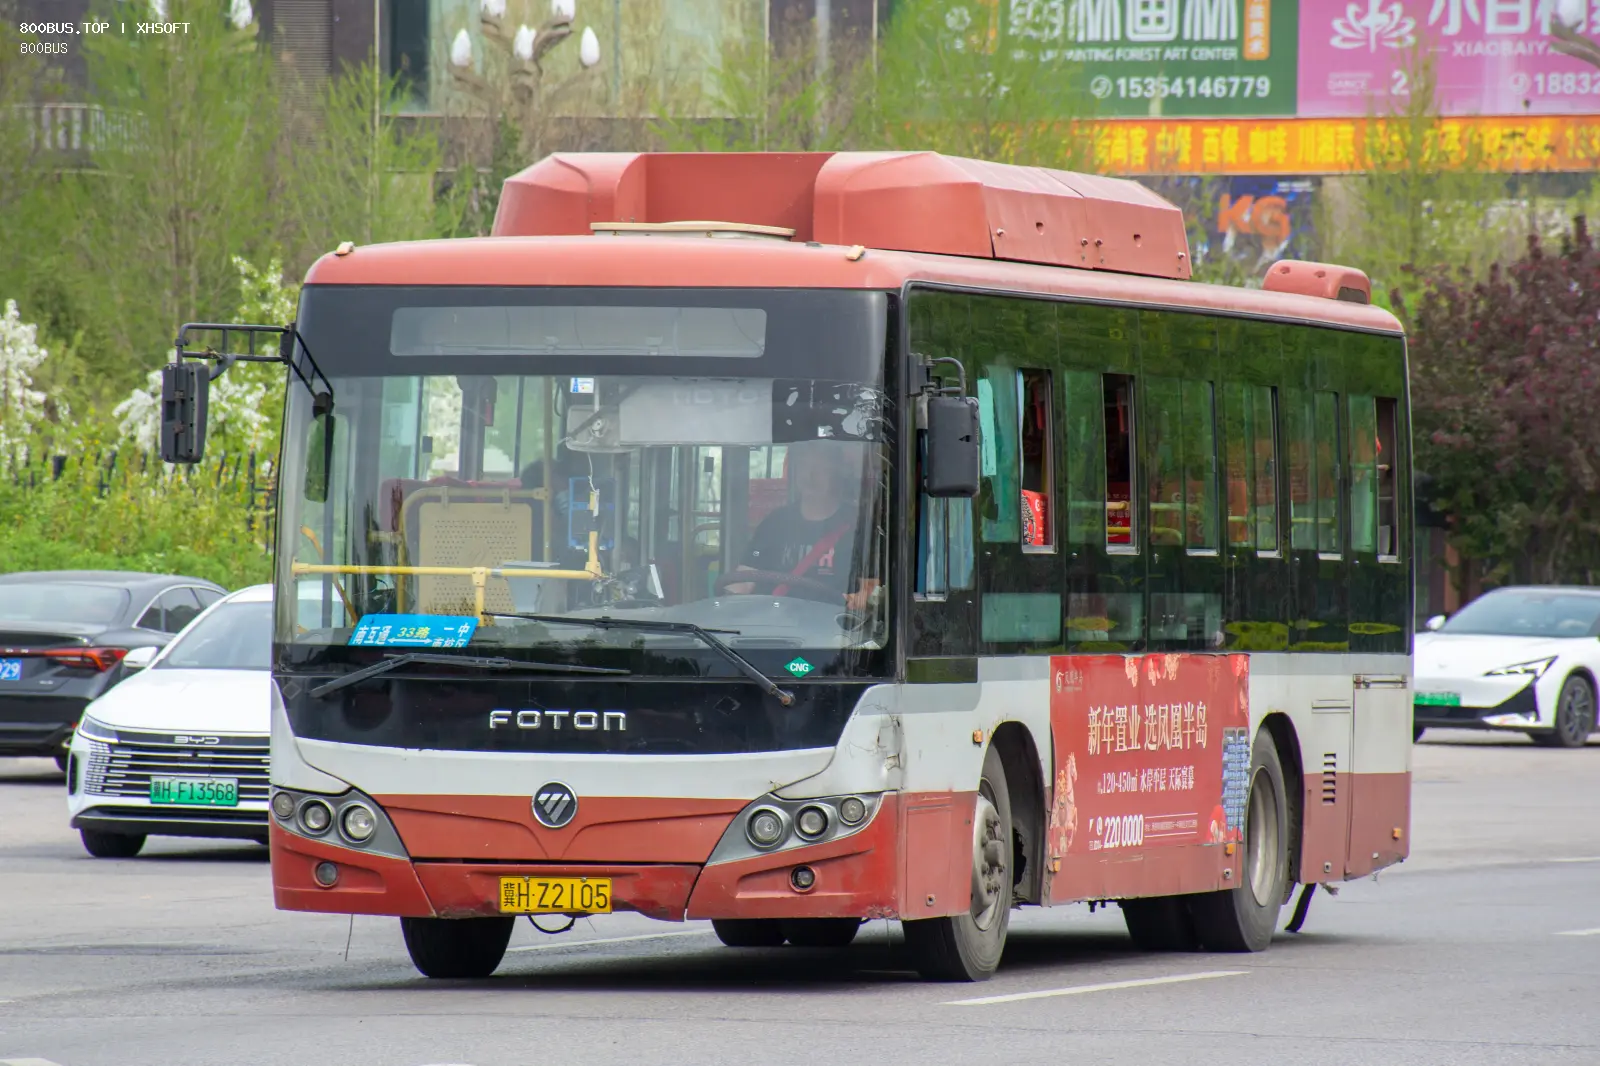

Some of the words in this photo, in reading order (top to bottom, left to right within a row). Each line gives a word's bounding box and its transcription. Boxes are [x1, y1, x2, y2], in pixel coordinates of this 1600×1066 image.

[1115, 47, 1161, 61] FOREST
[1163, 47, 1188, 60] ART
[1190, 47, 1238, 61] CENTER
[1452, 40, 1556, 57] XIAOBAIY
[1116, 76, 1271, 98] 15354146779
[1249, 124, 1288, 165] 咖啡
[397, 626, 431, 639] 33路
[443, 622, 470, 638] 一中
[0, 662, 20, 679] 29
[790, 662, 809, 672] CNG
[489, 710, 627, 731] FOTON
[1088, 704, 1141, 755] 新年置业
[1144, 700, 1208, 751] 选凤凰半岛
[174, 735, 220, 745] BYD
